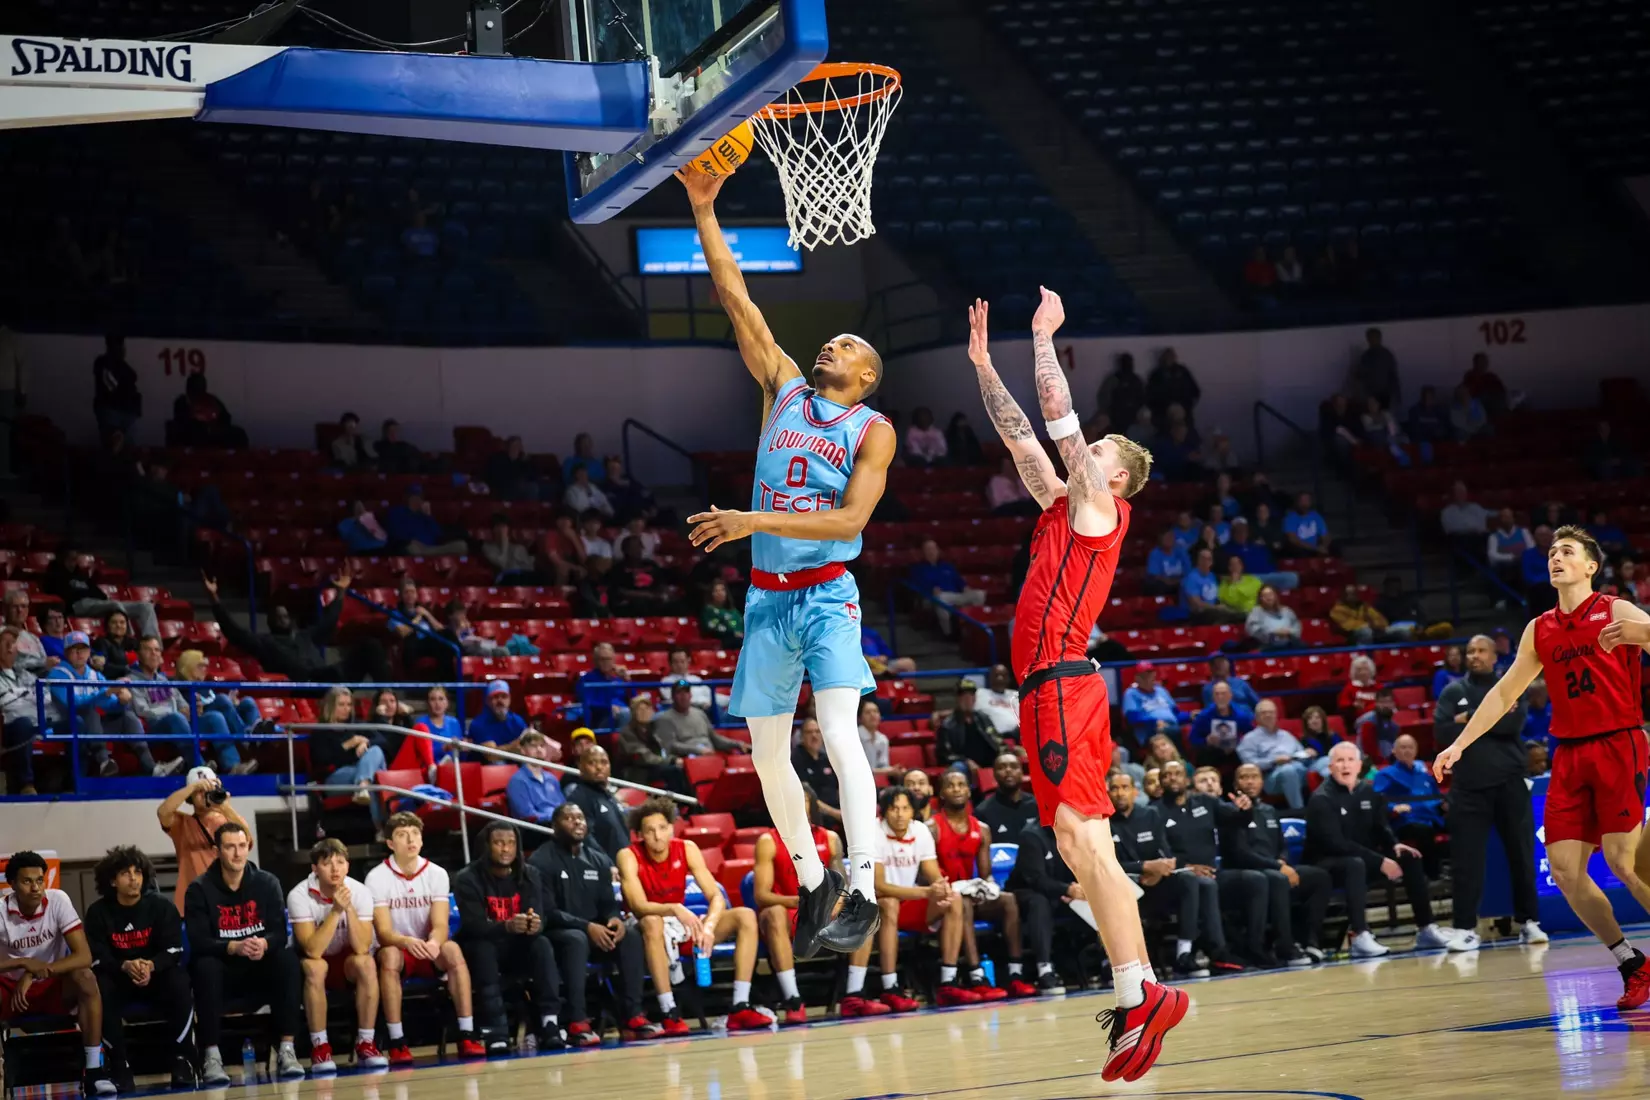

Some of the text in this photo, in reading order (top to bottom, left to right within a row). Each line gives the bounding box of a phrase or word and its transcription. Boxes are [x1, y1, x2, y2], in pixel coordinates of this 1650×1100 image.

[11, 38, 192, 83] SPALDING
[718, 140, 743, 168] Wil
[1478, 319, 1528, 346] 102
[158, 347, 206, 377] 119
[767, 427, 848, 471] LOUISIANA
[785, 455, 809, 489] 0
[759, 480, 838, 513] TECH
[1565, 667, 1596, 699] 24
[219, 921, 265, 938] BASKETBALL
